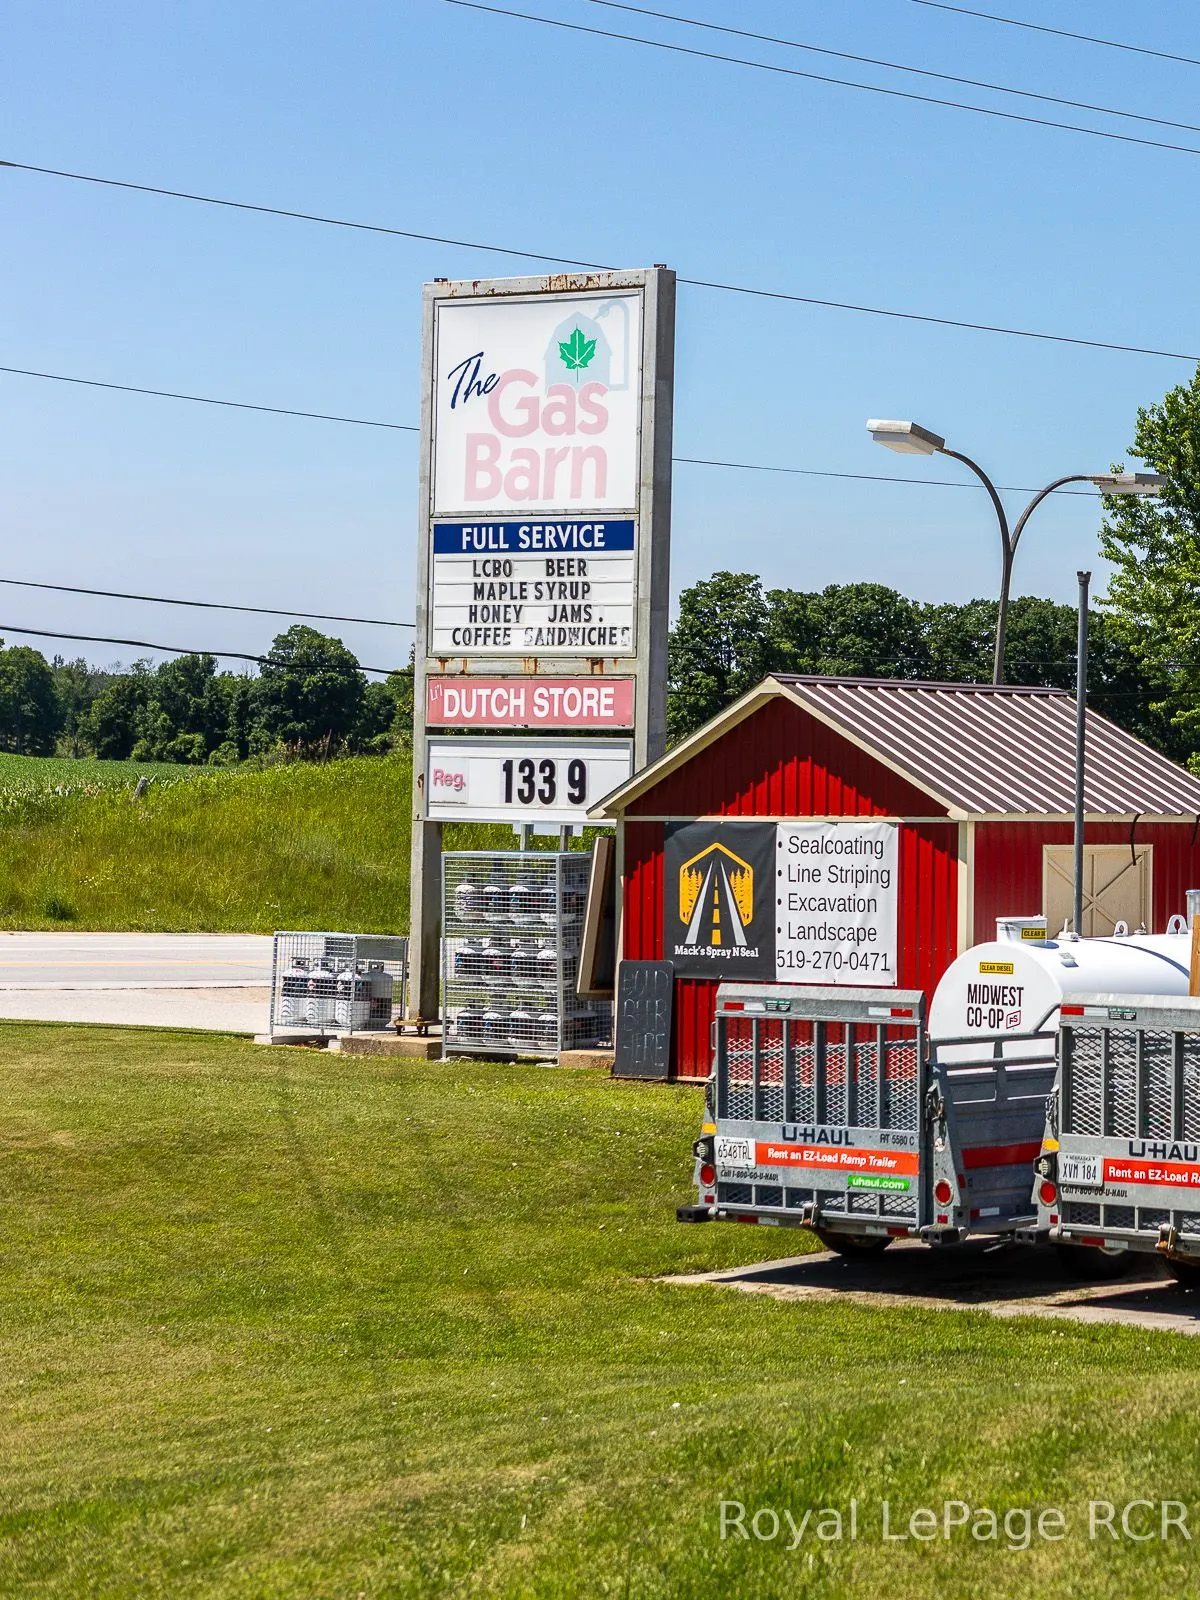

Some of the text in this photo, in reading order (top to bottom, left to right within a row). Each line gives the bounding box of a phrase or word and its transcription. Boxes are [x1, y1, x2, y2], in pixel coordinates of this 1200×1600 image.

[448, 351, 500, 409] The
[487, 368, 609, 438] Gas
[464, 432, 608, 501] Barn
[462, 524, 606, 550] FULL SERVICE
[472, 558, 587, 577] LCBO BEER
[473, 581, 591, 600] MAPLE SYRUP
[469, 605, 523, 623] HONEY
[452, 628, 511, 646] COFFEE
[443, 688, 525, 718] DUTCH
[533, 687, 614, 718] STORE
[433, 768, 466, 791] Reg.
[788, 835, 884, 859] Sealcoating
[788, 864, 891, 888] Line Striping
[788, 893, 877, 913] Excavation
[788, 922, 877, 946] Landscape
[674, 945, 759, 958] Mack's Spray N Seal
[777, 950, 891, 972] 519-270-0471
[967, 984, 1024, 1007] MIDWEST
[967, 1007, 1004, 1029] CO-OP
[1009, 1015, 1018, 1024] FS
[782, 1126, 854, 1145] U-HAUL
[909, 1137, 915, 1146] C
[718, 1145, 752, 1160] 6548TRL
[768, 1148, 897, 1168] Rent an EZ-Load Ramp Trailer
[1063, 1163, 1097, 1180] XVM 184
[1109, 1166, 1131, 1178] Rent
[1134, 1171, 1145, 1180] an
[1148, 1169, 1188, 1182] EZ-Load
[852, 1177, 904, 1190] uhaul.com
